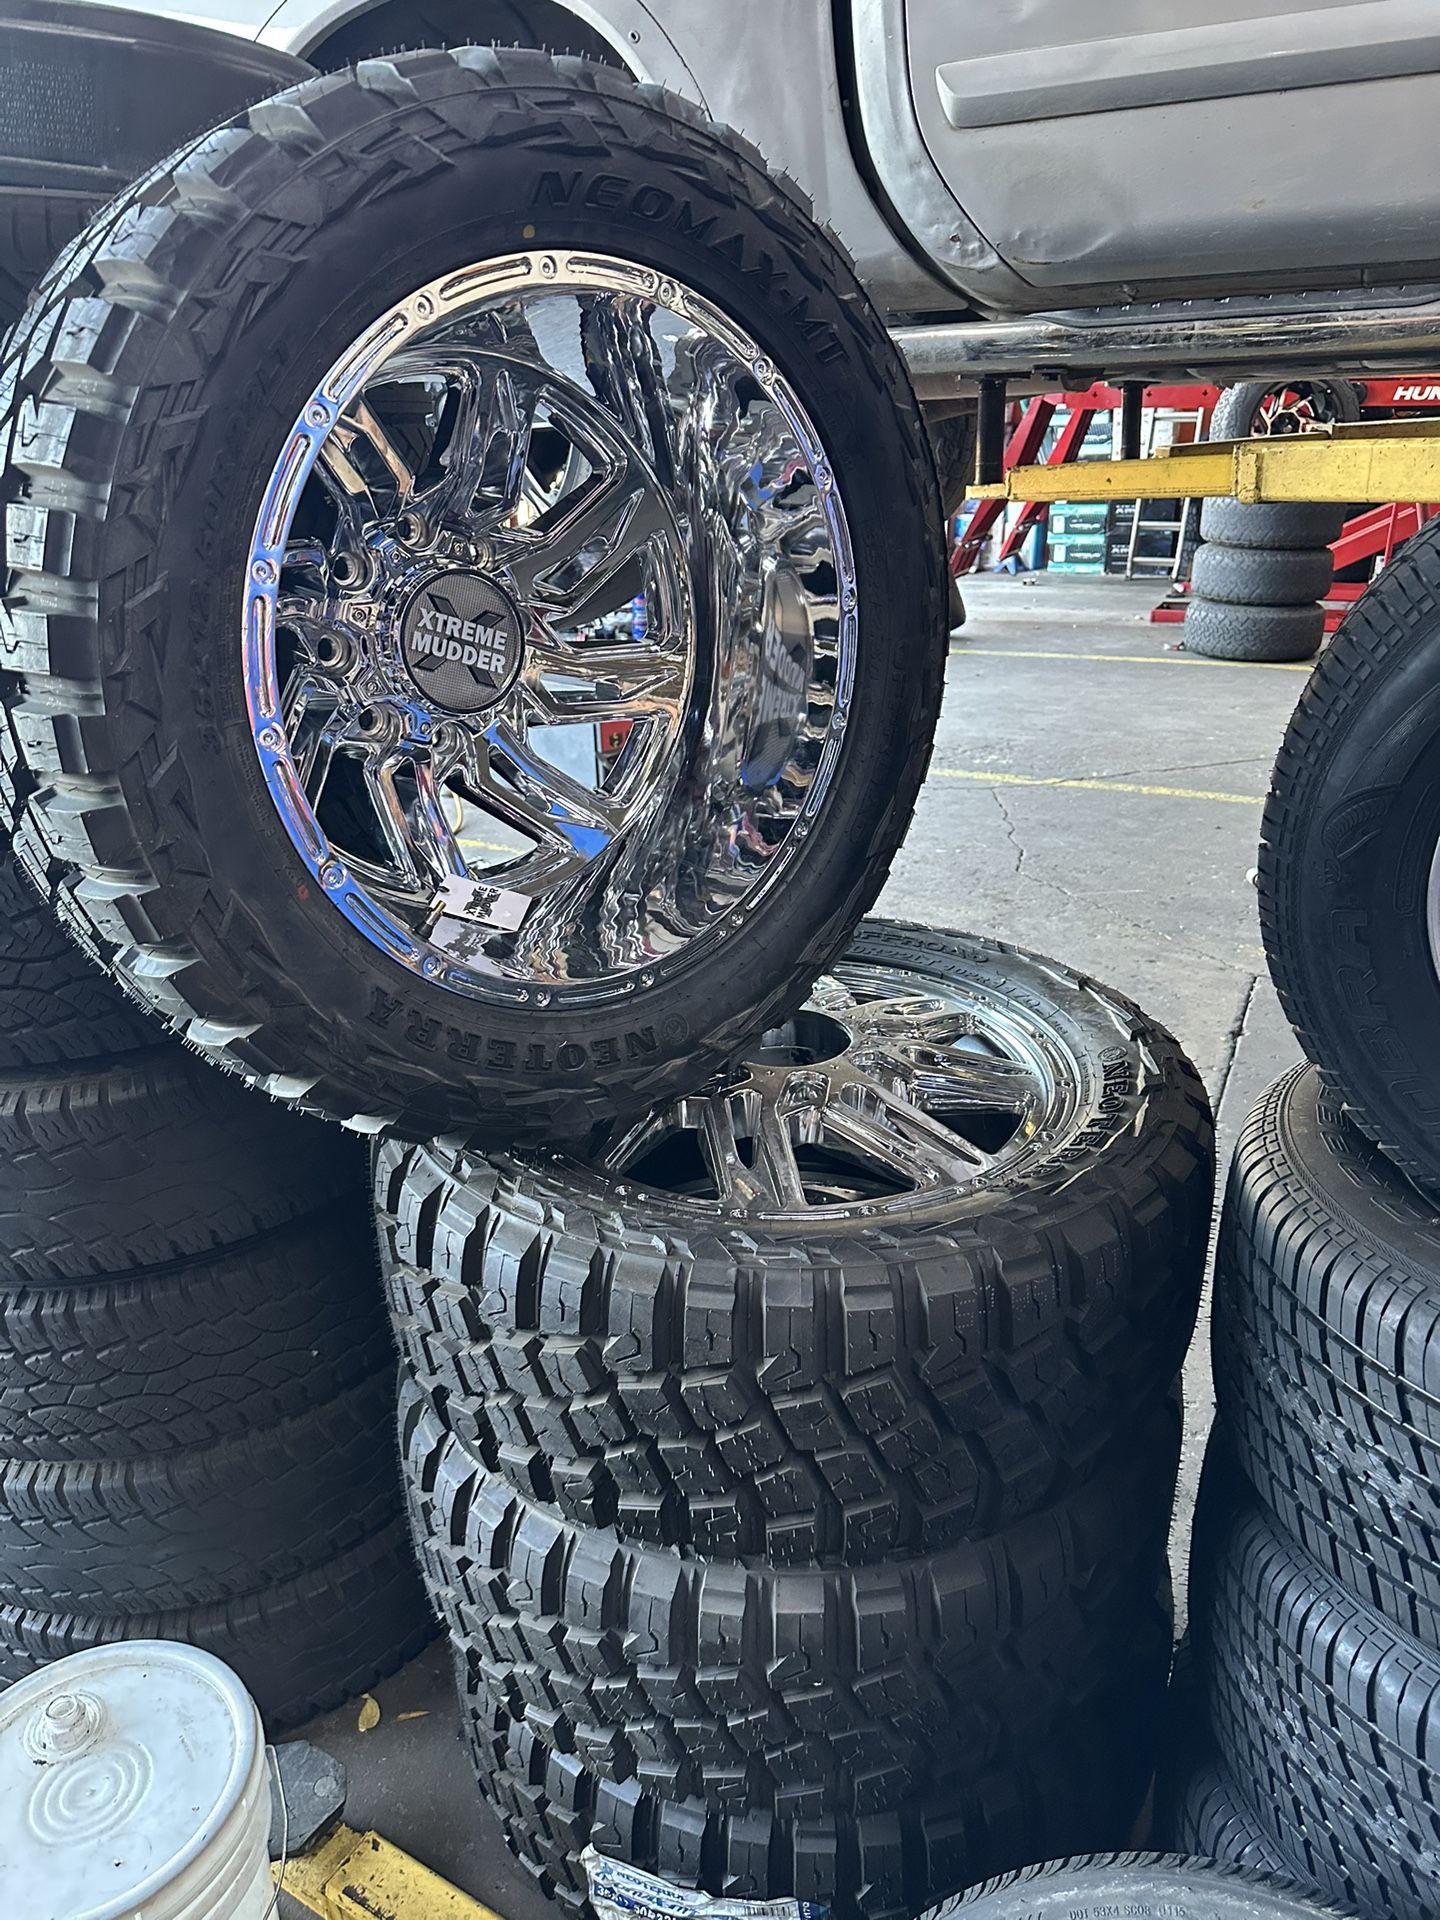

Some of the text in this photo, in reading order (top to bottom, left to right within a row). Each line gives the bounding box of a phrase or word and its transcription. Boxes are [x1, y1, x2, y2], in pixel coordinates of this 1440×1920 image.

[417, 607, 508, 651] XTREME
[411, 630, 506, 674] MUDDER
[364, 986, 660, 1073] NEOTERRA
